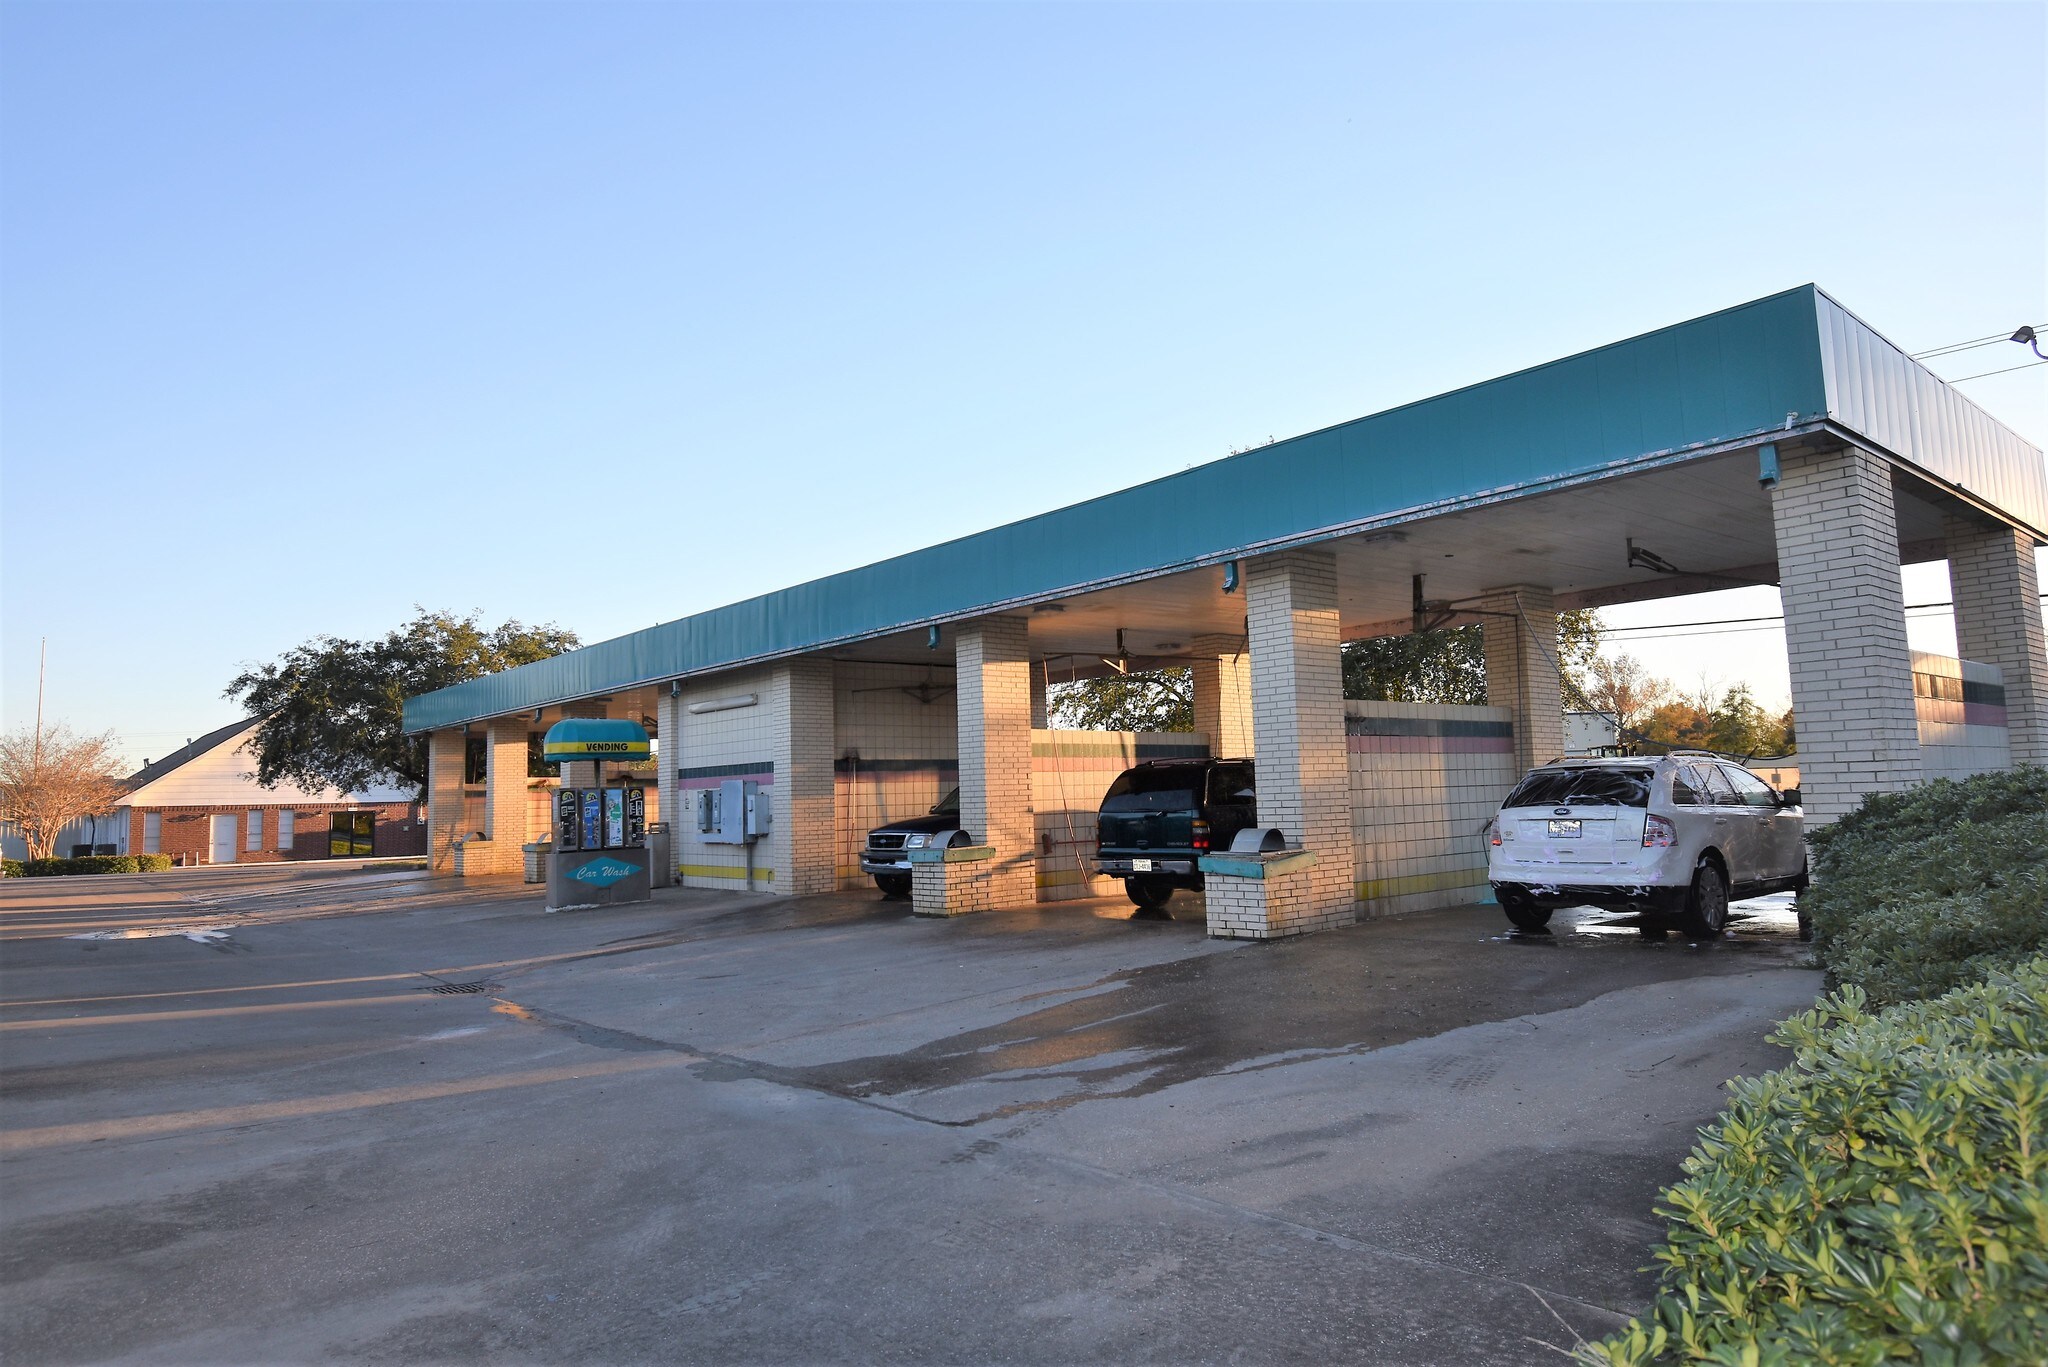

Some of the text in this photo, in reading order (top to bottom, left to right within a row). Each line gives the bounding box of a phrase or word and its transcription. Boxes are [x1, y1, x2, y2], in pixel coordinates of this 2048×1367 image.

[586, 742, 628, 752] VENDING
[576, 865, 630, 880] Car Wash
